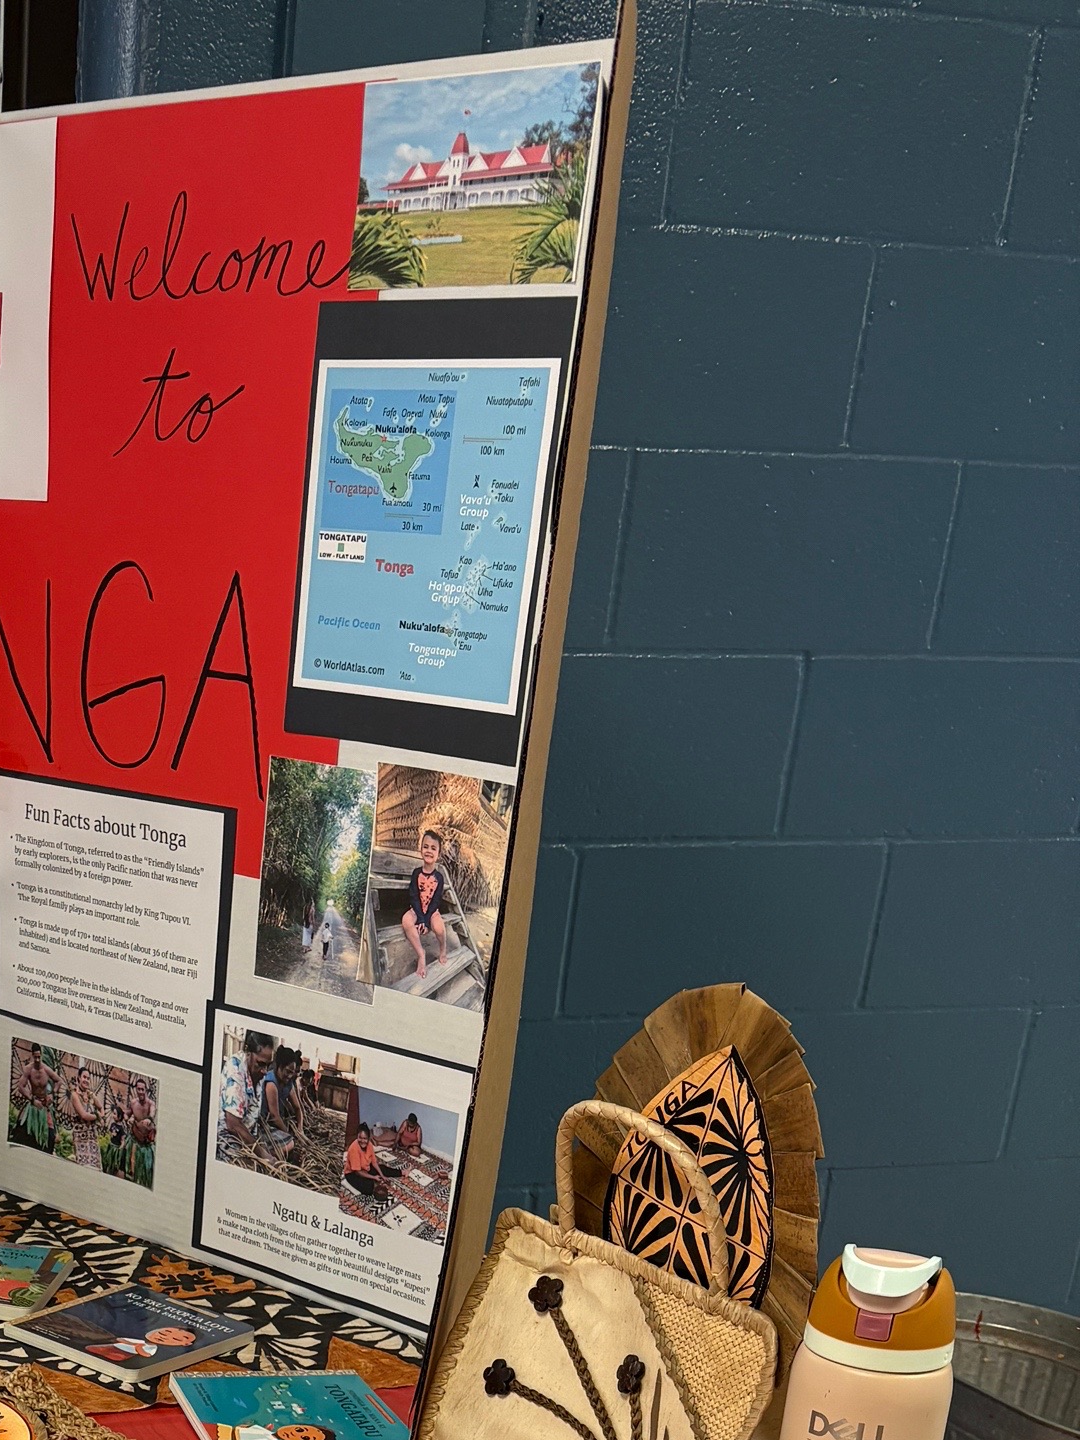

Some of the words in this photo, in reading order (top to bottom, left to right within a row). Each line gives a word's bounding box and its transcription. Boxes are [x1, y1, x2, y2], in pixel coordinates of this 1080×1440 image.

[70, 190, 351, 302] Welcome
[113, 348, 245, 457] to
[418, 394, 436, 403] Motu
[375, 424, 417, 434] Nuku'alofa
[425, 428, 451, 439] Kolonga
[502, 425, 516, 435] 100
[517, 426, 527, 435] mi
[480, 446, 492, 455] 100
[493, 446, 505, 456] km
[328, 480, 379, 497] Tongatapu
[422, 503, 432, 512] 30
[433, 503, 442, 512] mi
[459, 506, 489, 520] Group
[402, 521, 411, 531] 30
[412, 522, 424, 531] km
[319, 532, 367, 543] TONGATAPU
[375, 558, 415, 577] Tonga
[431, 592, 461, 606] Group
[318, 615, 350, 629] Pacific
[352, 618, 381, 631] Ocean
[399, 620, 446, 634] Nuku'alofa
[408, 642, 457, 658] Tongatapu
[323, 659, 386, 676] WorldAtlas.com
[417, 655, 446, 670] Group
[25, 803, 50, 824] Fun
[53, 808, 91, 831] Facts
[93, 815, 137, 839] about
[139, 823, 187, 852] Tonga
[15, 833, 27, 844] The
[27, 836, 56, 849] Kingdom
[56, 841, 63, 850] of
[63, 843, 87, 855] Tonga,
[87, 848, 115, 859] referred
[115, 853, 123, 861] to
[123, 854, 131, 862] as
[132, 854, 143, 864] the
[14, 845, 22, 856] by
[22, 848, 39, 859] early
[39, 851, 72, 864] explorers,
[72, 855, 79, 864] is
[79, 857, 91, 867] the
[91, 860, 106, 871] only
[106, 862, 129, 874] Pacific
[129, 868, 150, 879] nation
[151, 871, 165, 881] that
[165, 875, 179, 885] was
[179, 878, 199, 888] never
[14, 857, 42, 871] formally
[42, 863, 74, 876] colonized
[74, 868, 83, 879] by
[88, 870, 112, 884] foreign
[112, 877, 134, 888] power.
[272, 1200, 308, 1226] Ngatu
[310, 1214, 322, 1230] &
[323, 1218, 375, 1248] Lalanga
[203, 1318, 235, 1334] LOTU
[324, 1383, 383, 1438] TONGATAPU
